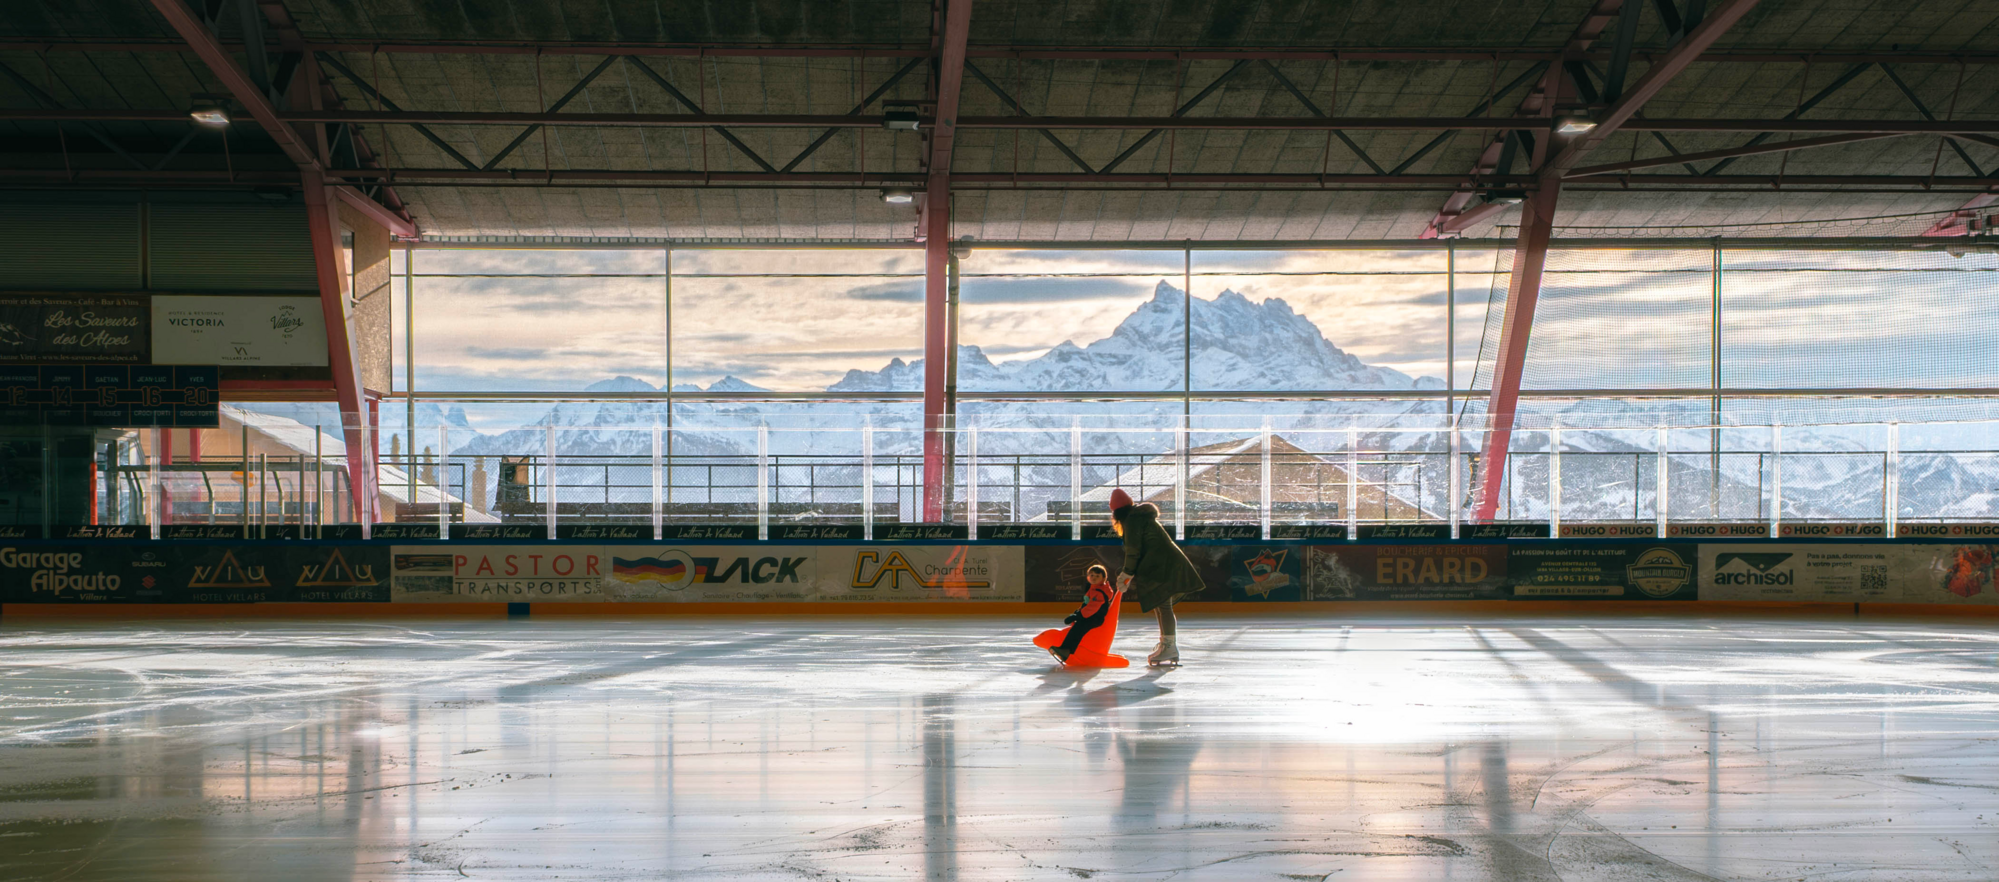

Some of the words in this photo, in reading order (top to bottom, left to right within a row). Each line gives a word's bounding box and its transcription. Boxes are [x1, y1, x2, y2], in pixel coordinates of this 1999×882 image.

[29, 297, 42, 306] des
[43, 298, 73, 306] Saveurs
[101, 298, 115, 306] Bar
[44, 310, 74, 328] Les
[75, 311, 140, 328] Saveurs
[168, 318, 225, 327] VICTORIA
[270, 314, 304, 333] Villars
[53, 333, 78, 345] des
[80, 330, 131, 348] Alpes
[8, 386, 28, 406] 12
[52, 386, 73, 407] 14
[97, 386, 118, 407] 15
[141, 386, 162, 407] 16
[184, 386, 209, 407] 20
[1572, 526, 1606, 536] HUGO
[1619, 526, 1654, 536] HUGO
[1680, 526, 1716, 536] HUGO
[1730, 525, 1766, 536] HUGO
[1794, 525, 1830, 535] HUGO
[1911, 525, 1949, 535] HUGO
[1377, 547, 1433, 556] BOUCHERIE
[1445, 546, 1488, 555] EPICERIE
[0, 547, 83, 574] Garage
[454, 554, 601, 576] PASTOR
[1831, 561, 1853, 569] projet
[924, 564, 988, 578] Charpente
[1376, 557, 1488, 584] ERARD
[1633, 568, 1662, 578] MOUNTAIN
[1714, 569, 1794, 586] archisol
[31, 569, 121, 596] Alpauto
[1537, 574, 1555, 582] 024
[1557, 574, 1575, 582] 495
[1588, 574, 1600, 582] 89
[455, 581, 592, 595] TRANSPORTS
[79, 593, 107, 601] Villars
[193, 593, 226, 601] HOTEL
[301, 592, 330, 600] HOTEL
[333, 592, 373, 600] VILLARS
[736, 591, 770, 600] Chauffage
